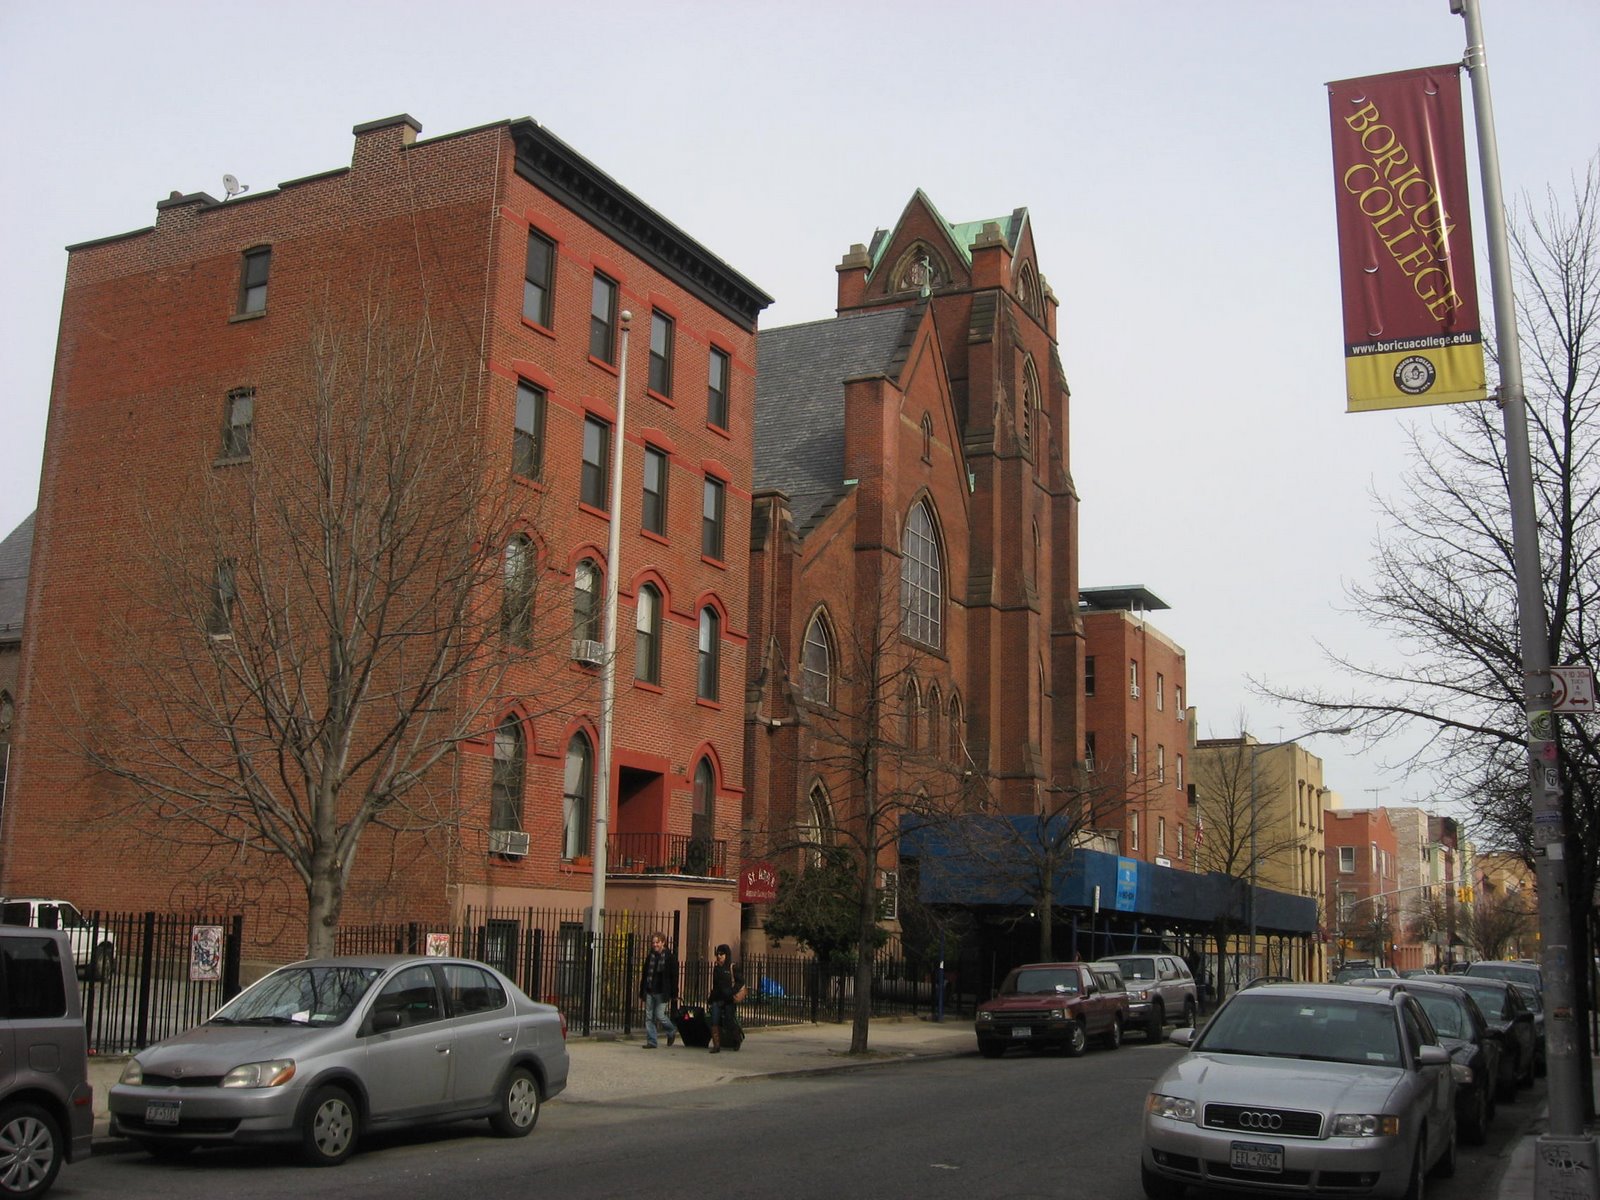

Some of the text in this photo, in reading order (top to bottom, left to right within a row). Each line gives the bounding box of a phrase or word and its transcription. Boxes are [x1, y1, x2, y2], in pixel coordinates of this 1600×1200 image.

[1344, 101, 1456, 252] BORICUA
[1345, 164, 1463, 321] COLLEGE
[1352, 333, 1472, 354] www.boricuacollege.edu
